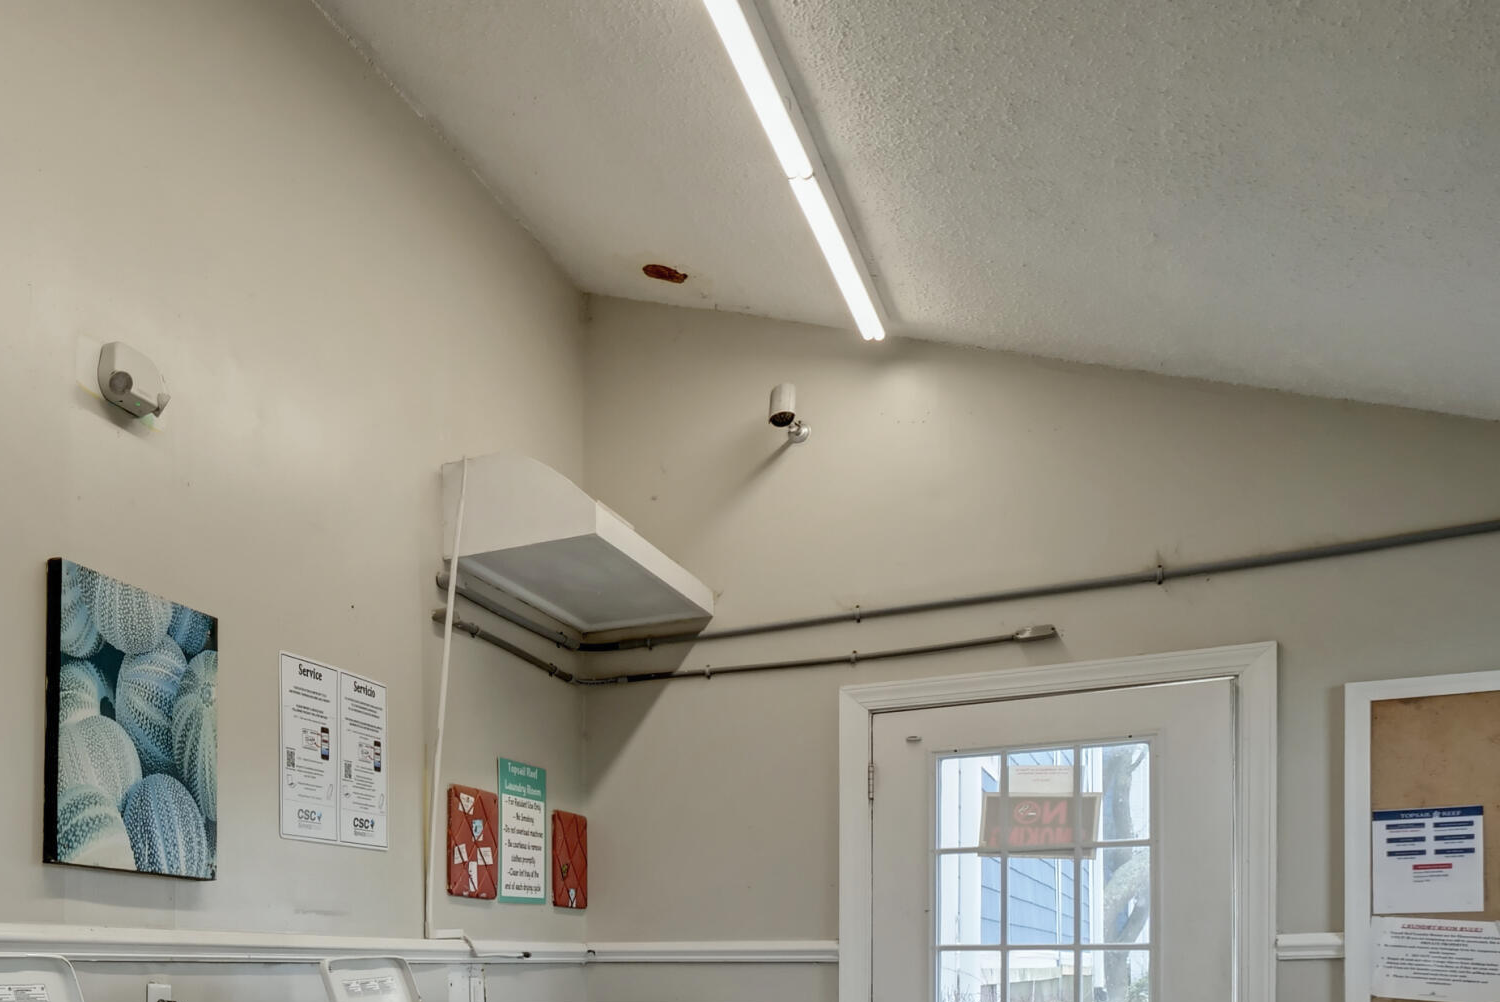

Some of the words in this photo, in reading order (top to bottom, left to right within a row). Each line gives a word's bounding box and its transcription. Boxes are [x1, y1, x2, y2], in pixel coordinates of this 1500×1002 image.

[298, 663, 322, 681] Service
[353, 680, 376, 698] Servicio
[508, 762, 526, 777] Topsail
[504, 779, 526, 796] Laundry
[526, 784, 541, 798] Room
[297, 808, 317, 821] CSC
[353, 817, 370, 829] CSC
